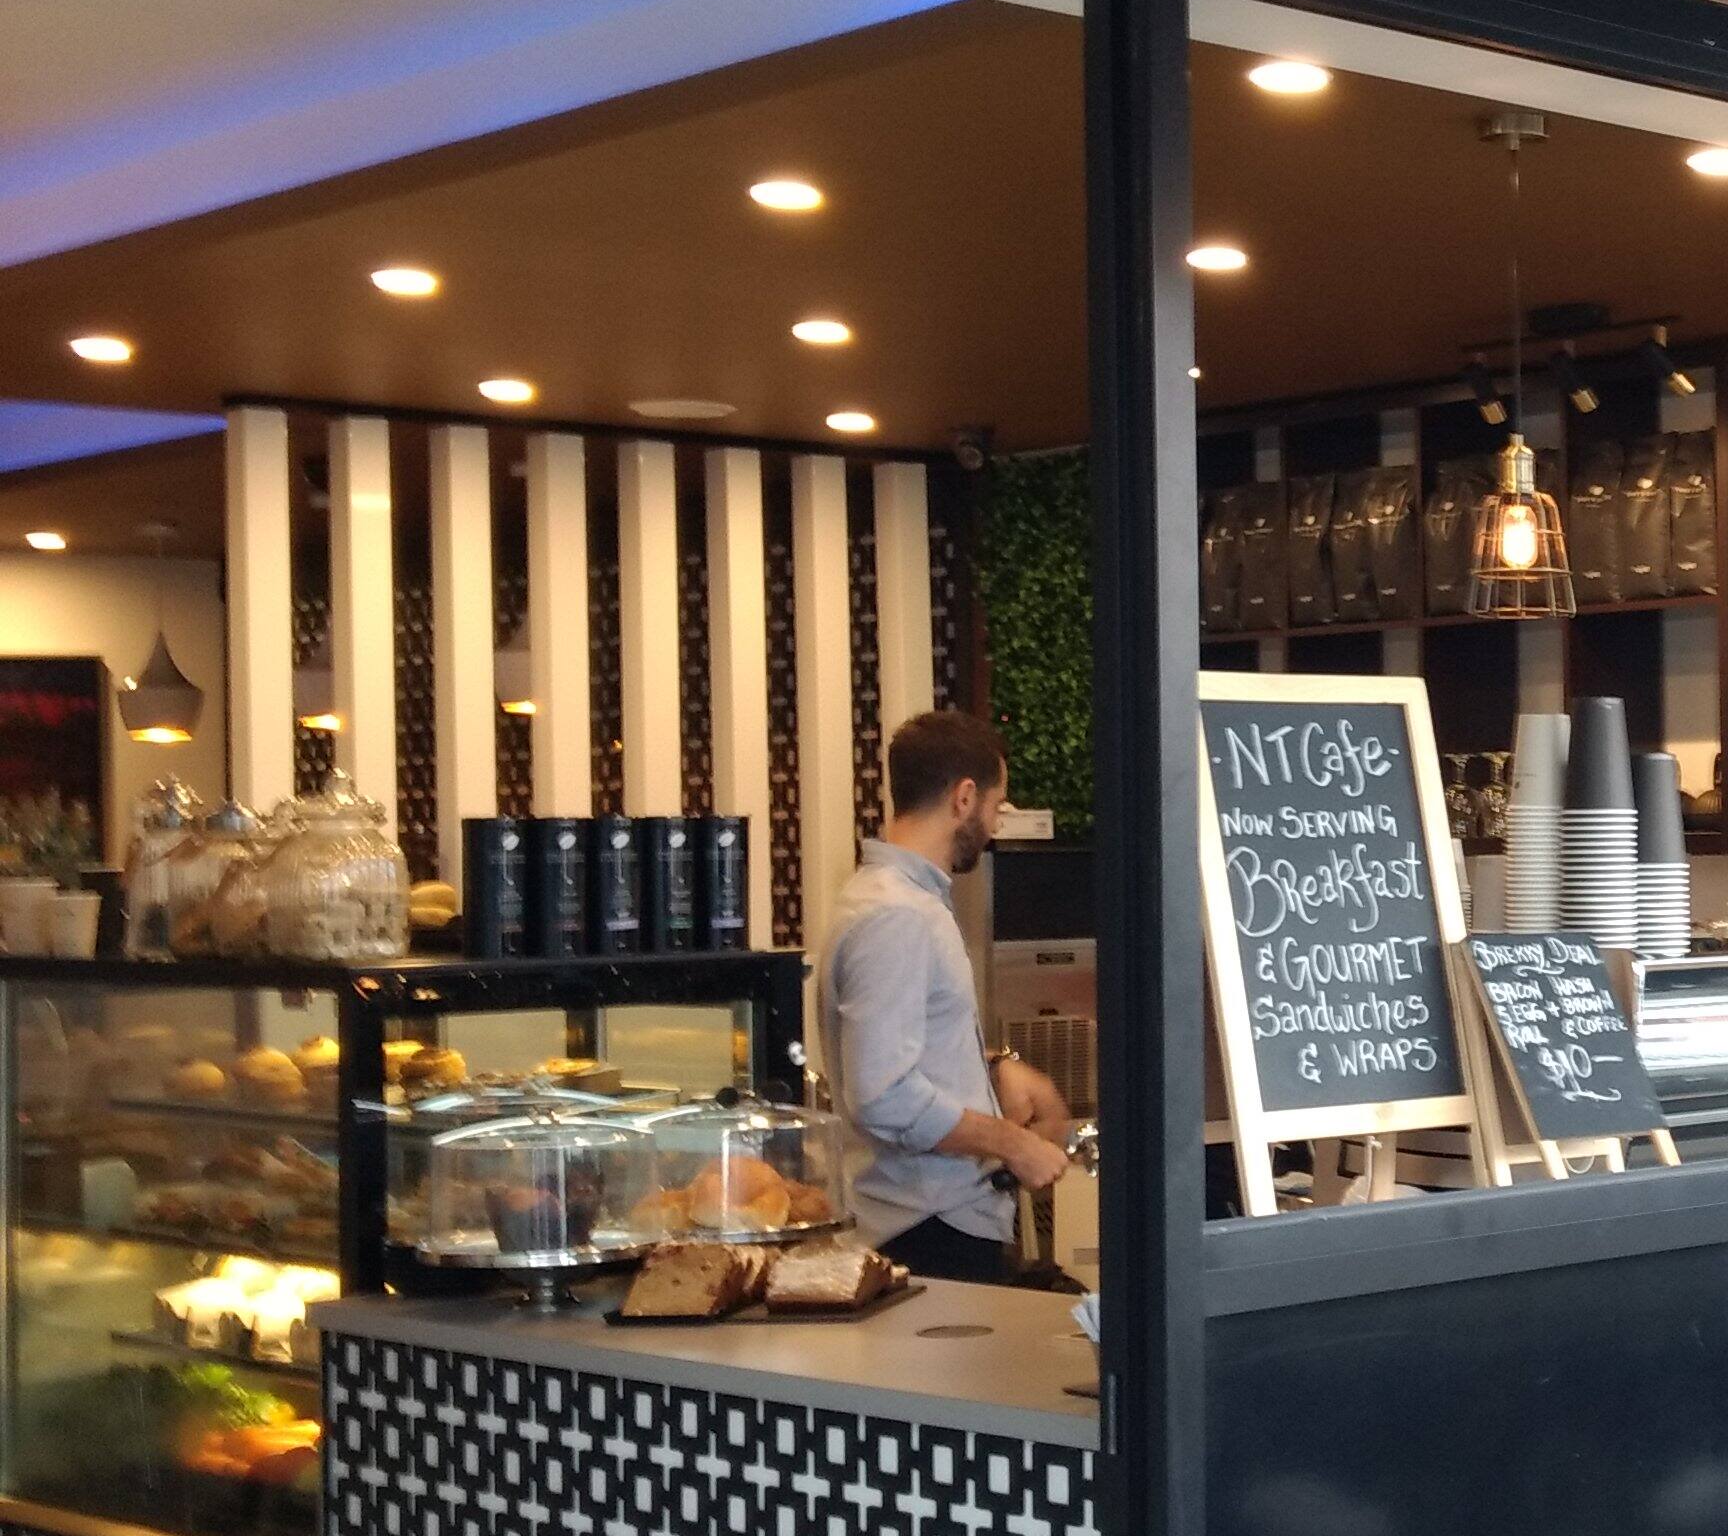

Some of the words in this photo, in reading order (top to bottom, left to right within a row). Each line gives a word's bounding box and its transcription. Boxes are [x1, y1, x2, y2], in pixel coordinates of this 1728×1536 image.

[1279, 804, 1398, 839] SERVING
[1485, 980, 1543, 1004] BACON
[1559, 989, 1615, 1015] BROWN
[1252, 990, 1430, 1040] Sandwiches
[1576, 1015, 1628, 1035] COFFEE
[1300, 1042, 1322, 1084] &
[1330, 1037, 1438, 1077] WRAPS
